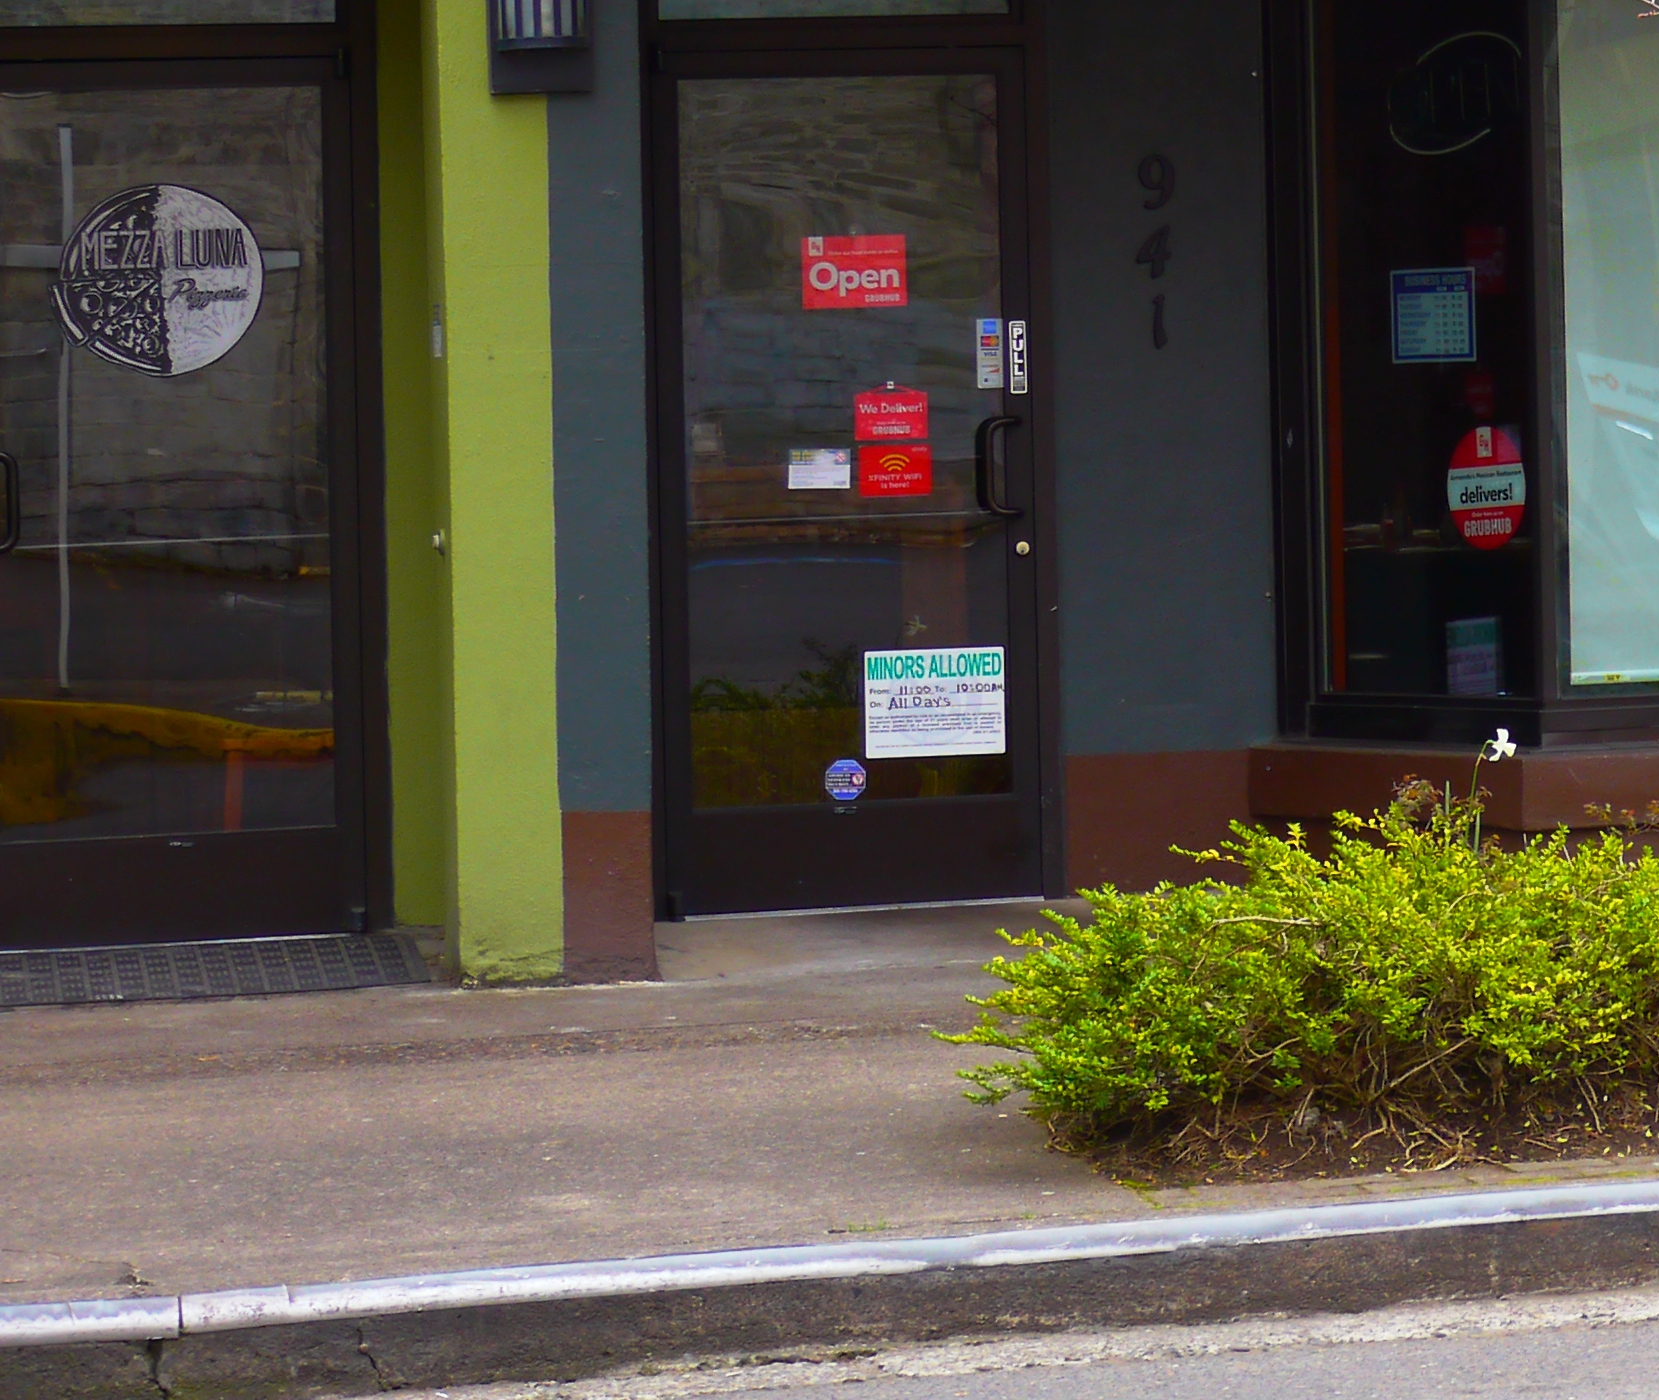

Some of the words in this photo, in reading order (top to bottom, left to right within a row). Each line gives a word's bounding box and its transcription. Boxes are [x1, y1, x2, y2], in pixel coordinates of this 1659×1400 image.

[81, 230, 169, 271] MEZZA
[175, 228, 248, 270] LUNA
[1136, 153, 1176, 351] 941
[168, 278, 249, 311] Pizzeria
[809, 261, 900, 297] Open
[1012, 327, 1024, 376] PULL
[859, 404, 878, 414] We
[881, 402, 923, 414] Deliver!
[1460, 482, 1513, 505] delivers!
[1464, 517, 1512, 537] GRUBHUB
[867, 655, 925, 680] MINORS
[928, 652, 1002, 678] ALLOWED
